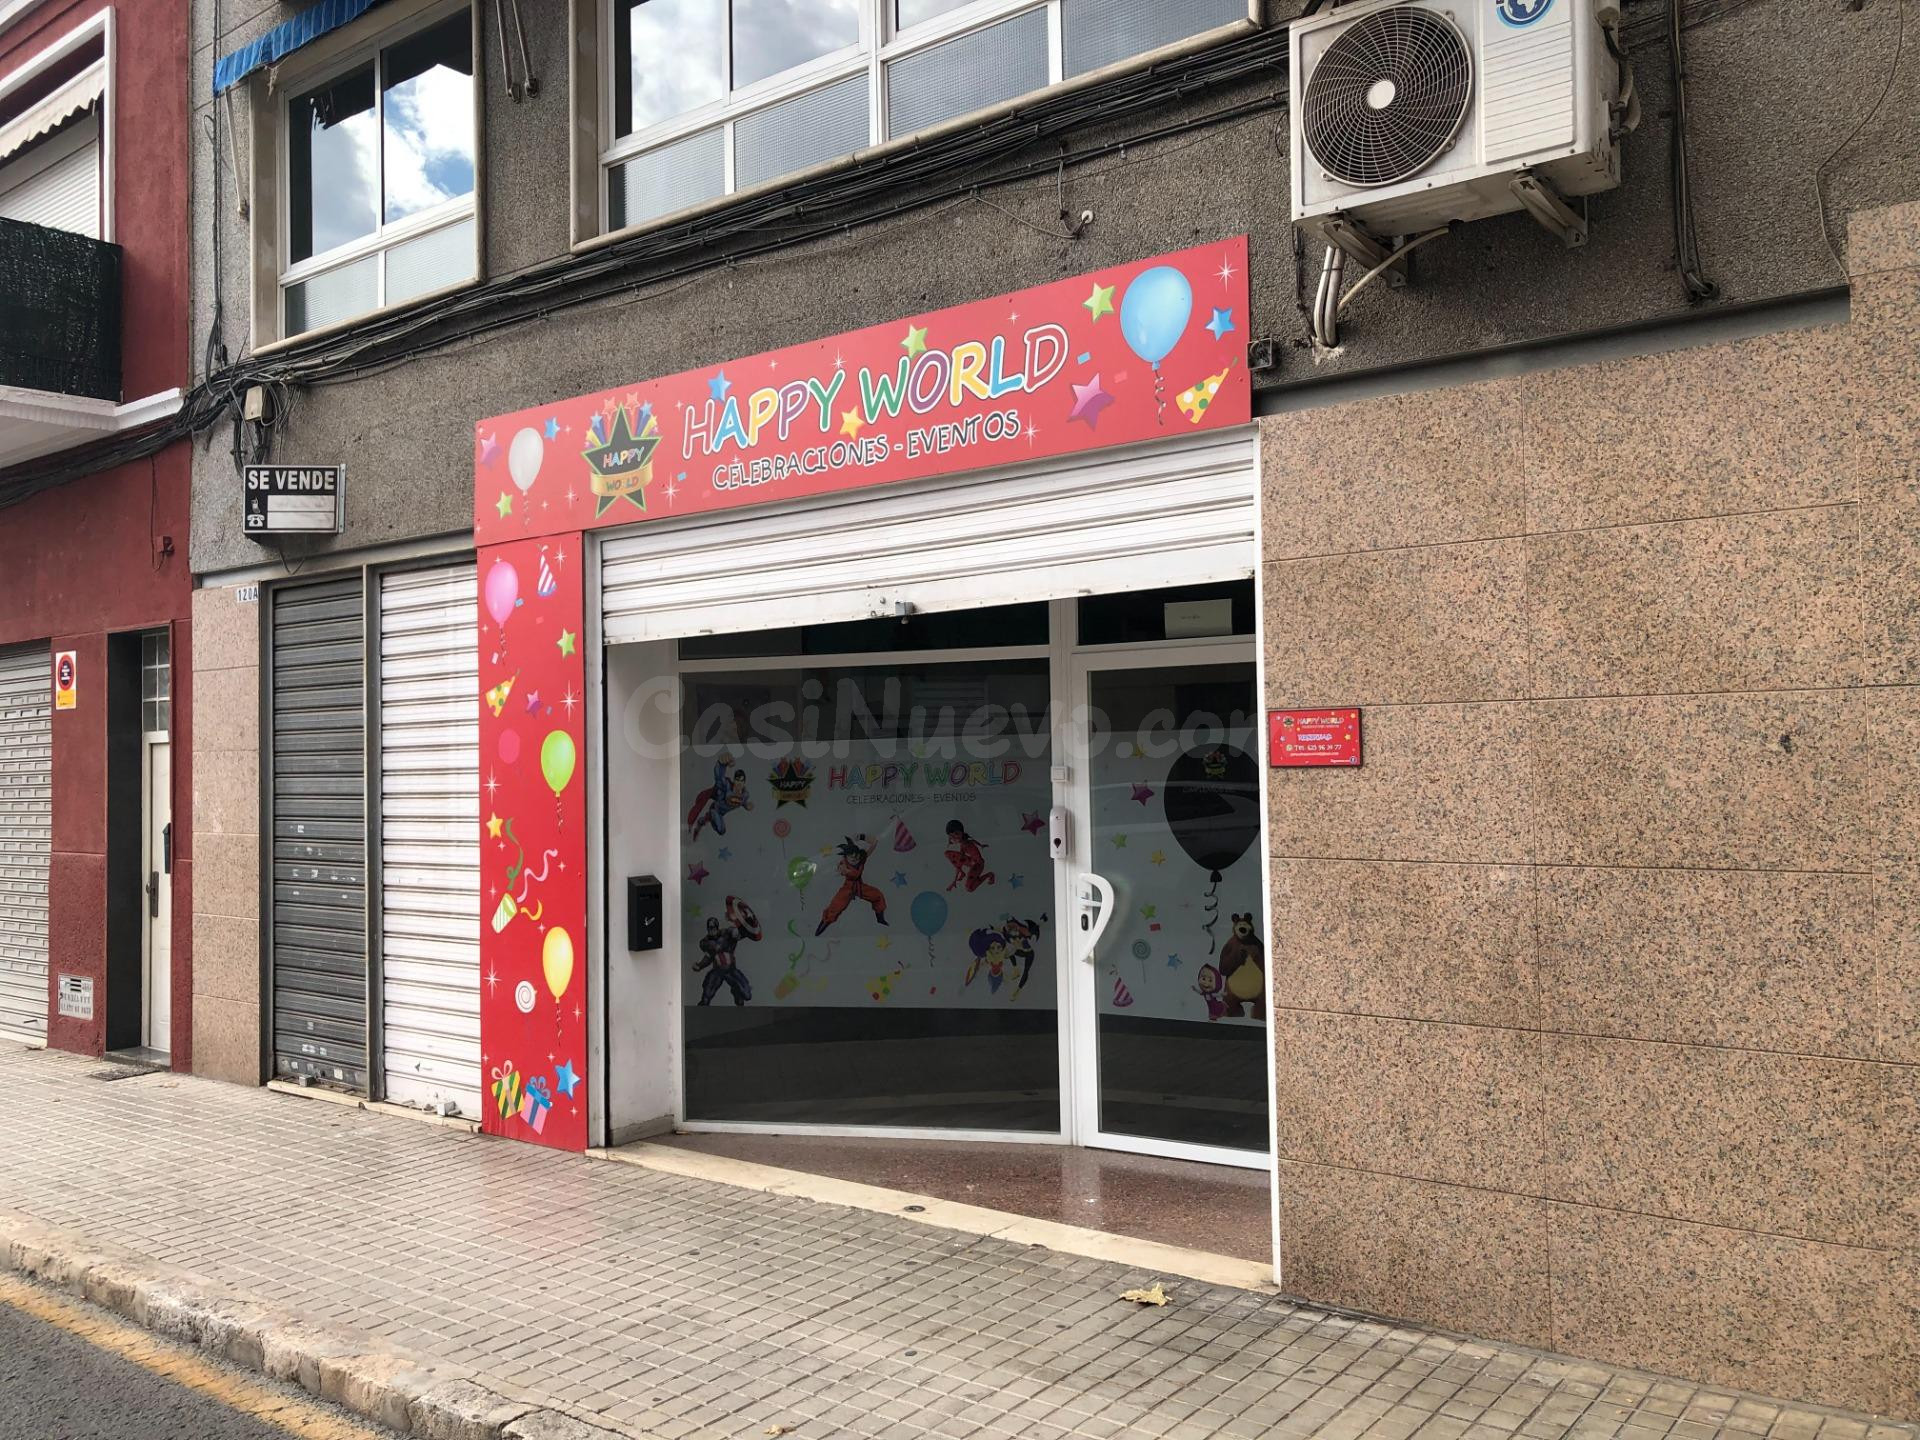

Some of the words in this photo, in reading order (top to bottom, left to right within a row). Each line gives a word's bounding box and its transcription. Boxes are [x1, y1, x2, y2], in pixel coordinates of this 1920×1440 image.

[683, 369, 846, 459] HAPPY
[859, 324, 1069, 424] WORLD
[603, 446, 645, 468] HAPPY
[713, 434, 890, 490] CELEBRACIONES
[907, 410, 1020, 458] EVENTOS
[248, 470, 270, 490] SE
[275, 470, 335, 490] VENDE
[606, 476, 639, 492] WOLD
[238, 587, 258, 601] 120A
[1297, 716, 1320, 725] HAPPY
[827, 761, 917, 790] HAPPY
[924, 760, 1022, 787] WORLD
[846, 793, 925, 805] CELEBRACIONES
[933, 792, 977, 803] EVENTOS
